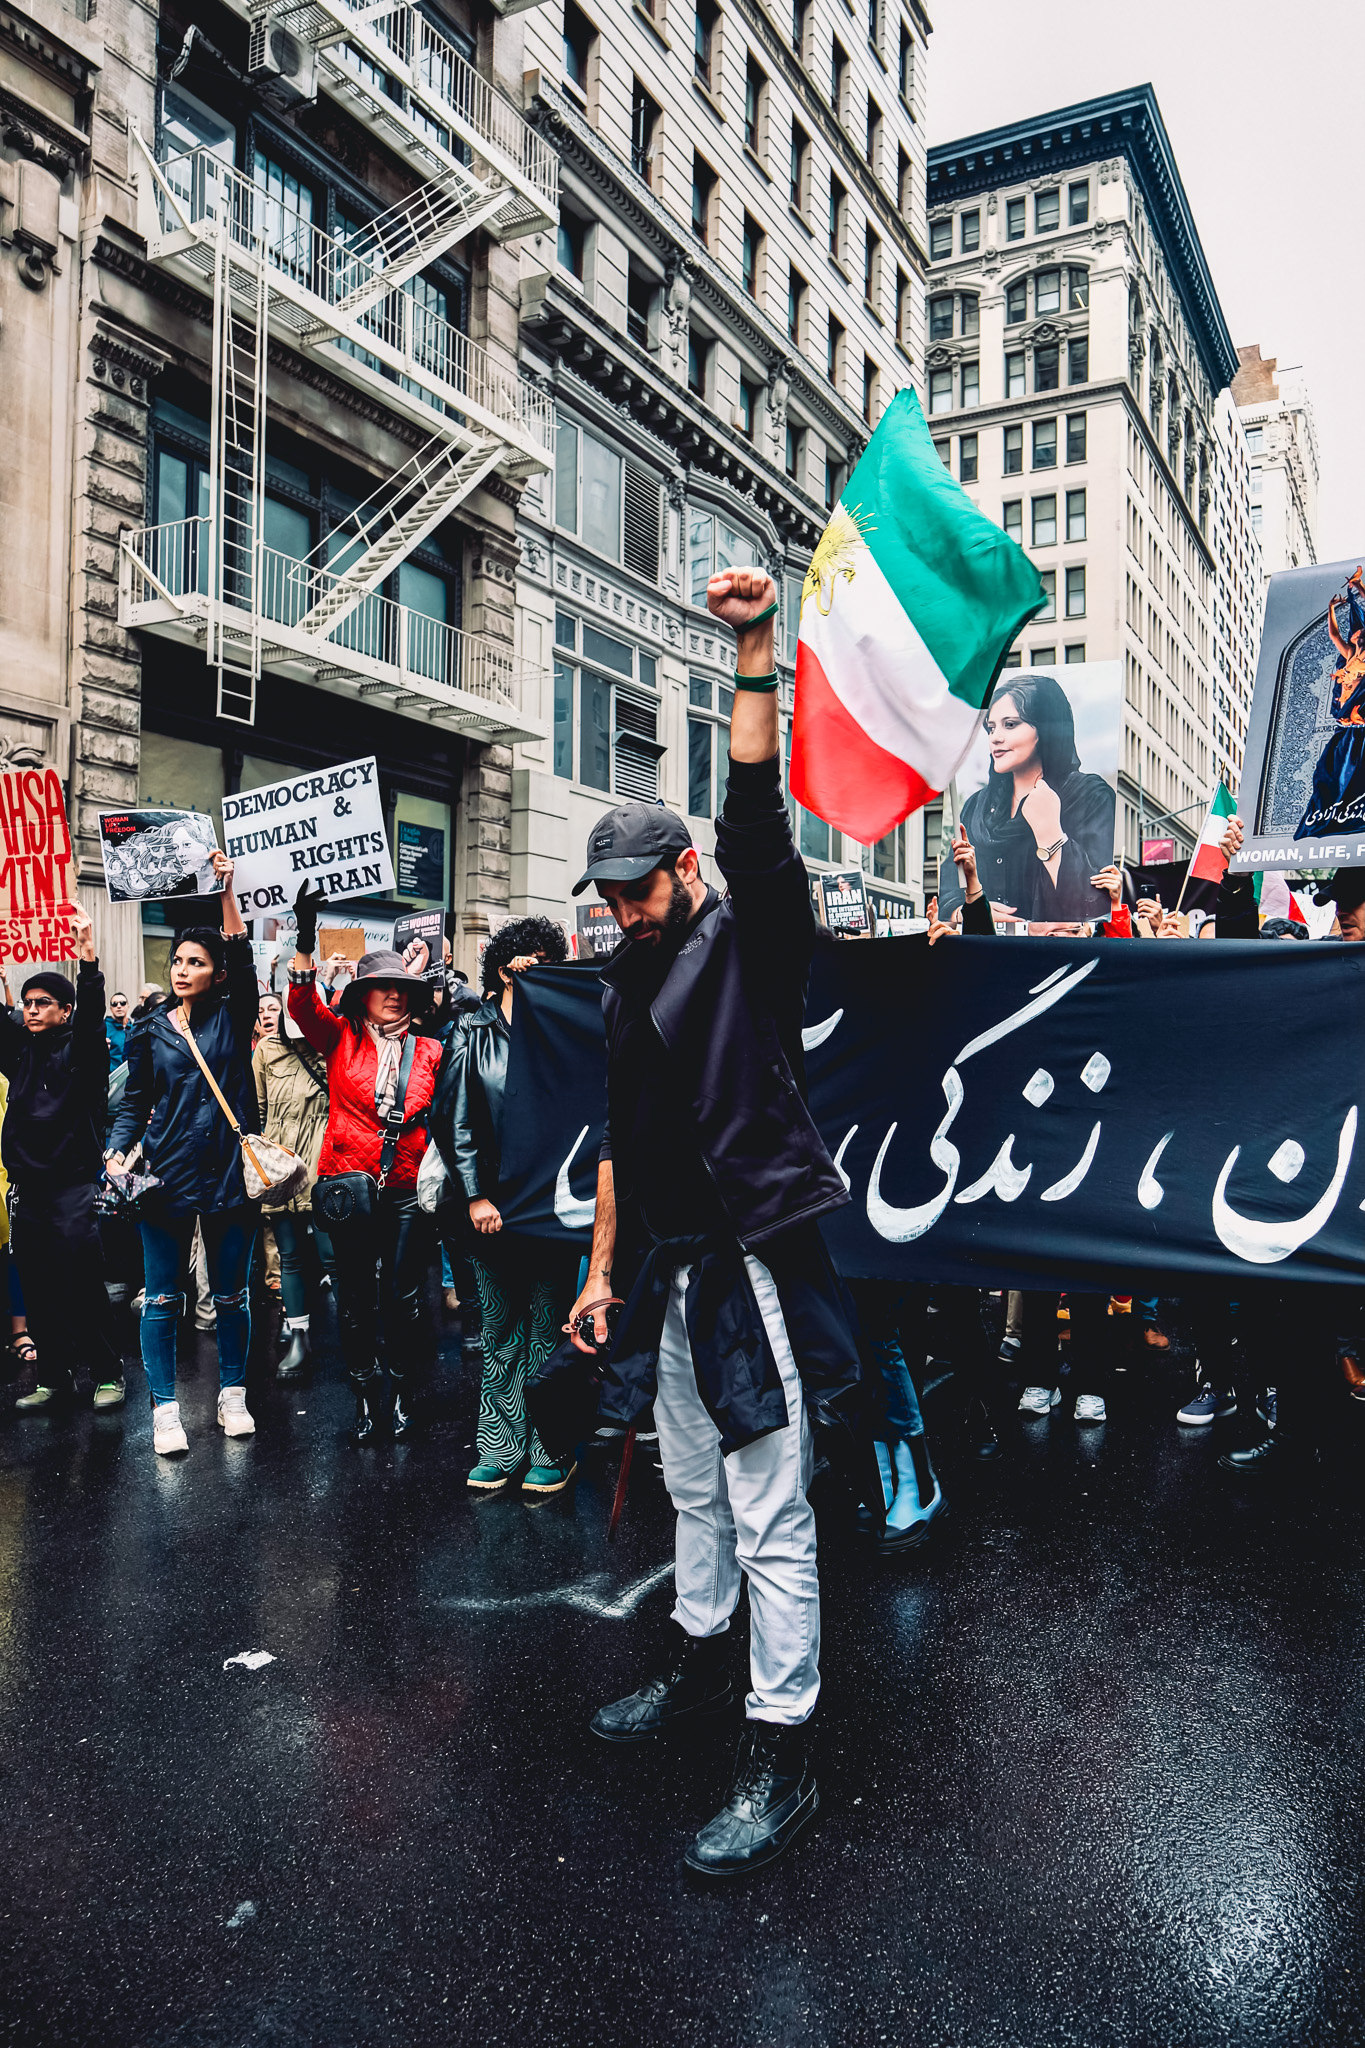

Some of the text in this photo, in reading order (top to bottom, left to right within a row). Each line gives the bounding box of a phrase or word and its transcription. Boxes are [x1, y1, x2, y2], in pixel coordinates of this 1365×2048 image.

[223, 762, 375, 822] DEMOCRACY
[333, 796, 352, 817] &
[228, 817, 318, 859] HUMAN
[290, 831, 384, 872] RIGHTS
[1236, 848, 1303, 863] WOMAN,
[1308, 845, 1351, 860] LIFE,
[237, 863, 382, 914] FOR IRAN
[826, 889, 863, 906] IRAN
[410, 914, 441, 929] women
[590, 906, 613, 918] IRA
[38, 917, 70, 939] IN
[582, 924, 624, 936] WOMA
[0, 936, 79, 965] POWER
